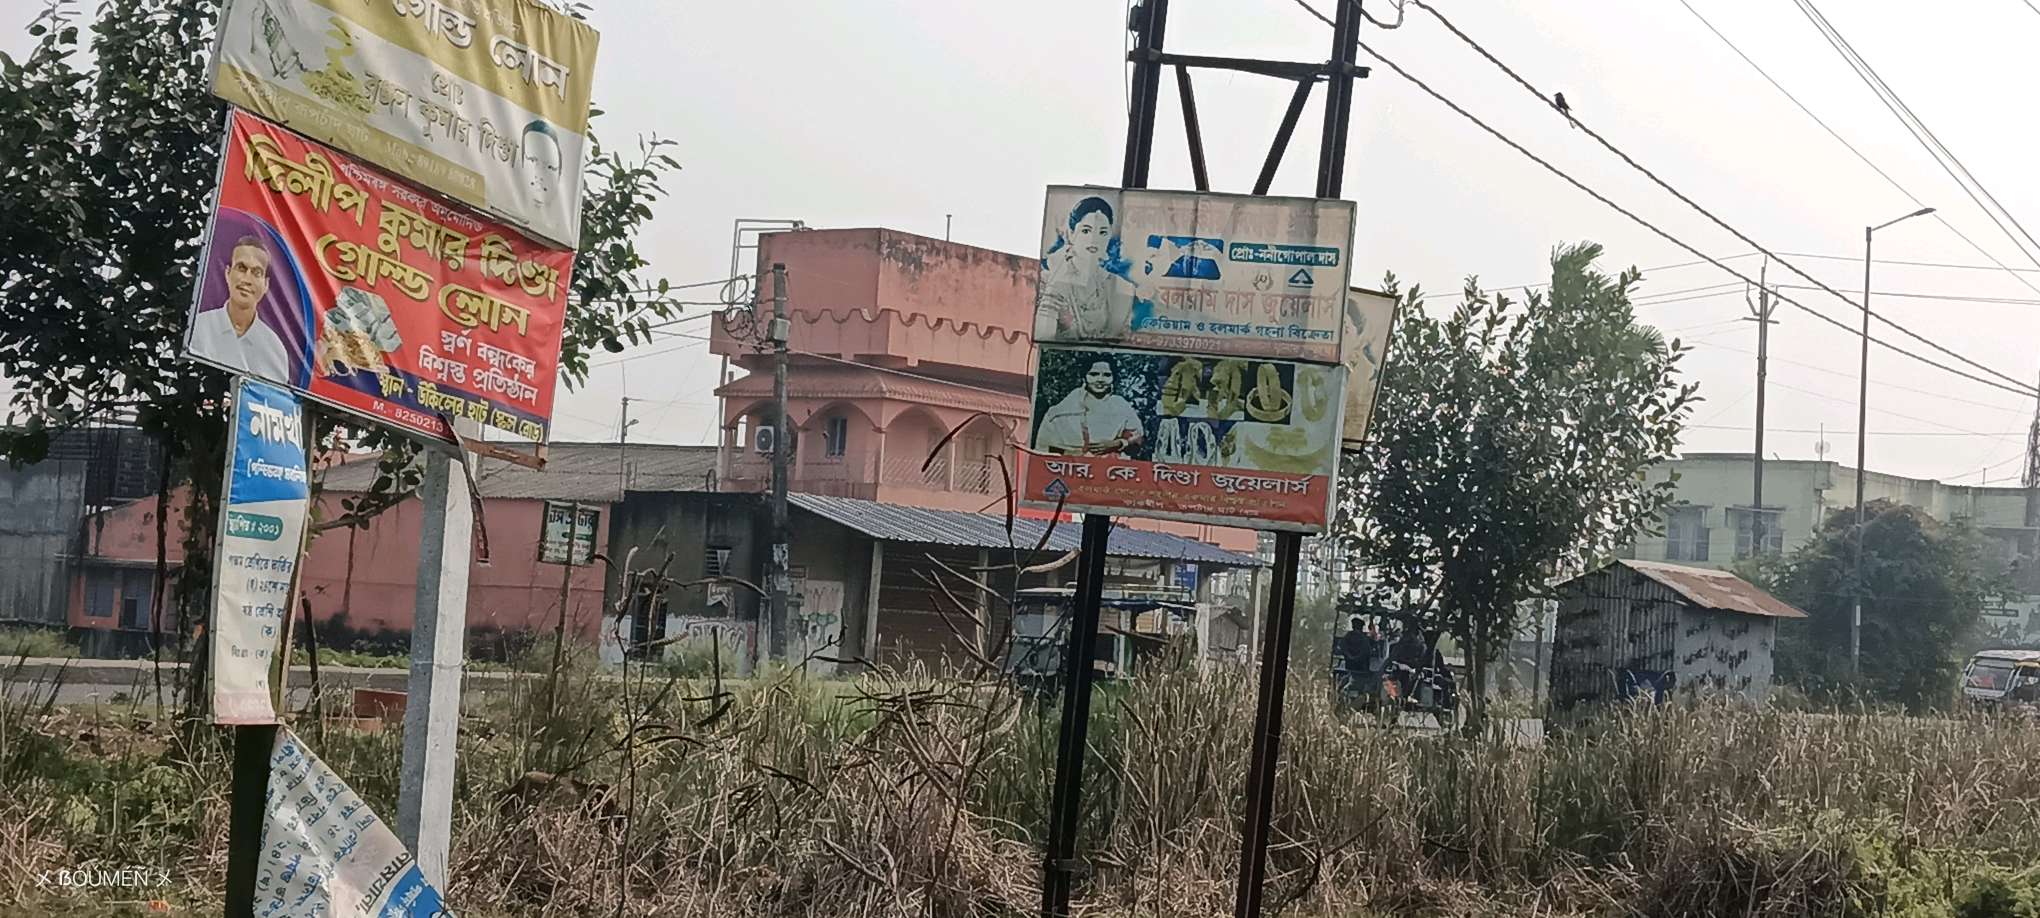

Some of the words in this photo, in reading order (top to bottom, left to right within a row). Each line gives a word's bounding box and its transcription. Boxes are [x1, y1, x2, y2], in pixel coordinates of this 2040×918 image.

[489, 34, 570, 104] লোন
[418, 98, 472, 150] কুমার
[243, 133, 370, 226] দিলীপ
[378, 200, 471, 272] কুমার
[439, 283, 531, 336] লোন
[440, 329, 472, 357] স্বর্ণ
[1197, 321, 1206, 332] ও
[1209, 319, 1253, 336] হলমার্ক
[1288, 324, 1335, 342] বিক্রেতা
[418, 345, 468, 384] বিশ্বস্ত
[473, 367, 539, 406] প্রতিষ্ঠান
[465, 392, 488, 423] হাট
[1045, 460, 1094, 479] আর.
[1106, 465, 1142, 482] কে.
[1211, 472, 1312, 497] জুয়েলার্স
[258, 524, 279, 535] ২০০১
[261, 625, 276, 638] (ক)
